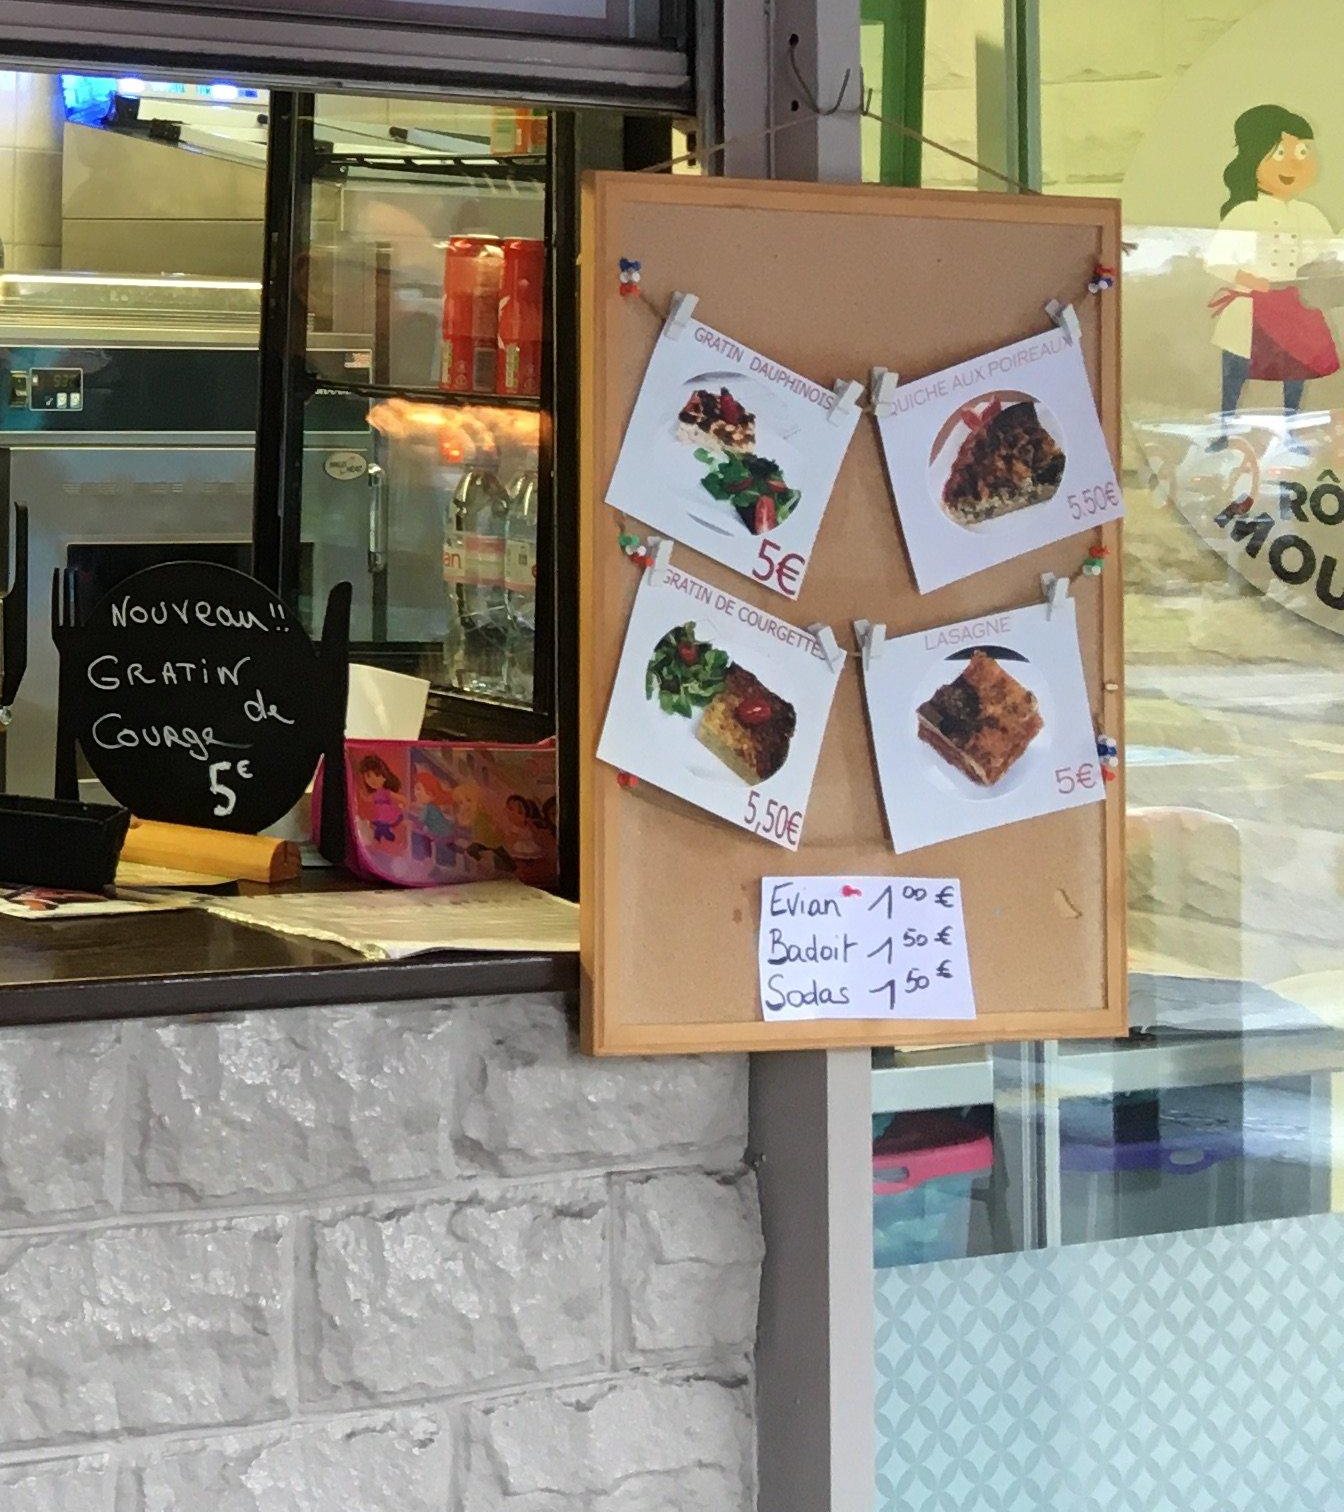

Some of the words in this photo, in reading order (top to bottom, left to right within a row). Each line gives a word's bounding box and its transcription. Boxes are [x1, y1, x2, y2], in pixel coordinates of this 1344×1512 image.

[694, 326, 745, 363] GRATIN
[749, 355, 836, 411] DAUPHINOIS
[952, 365, 986, 390] AUX
[1067, 482, 1119, 521] 5.50€
[752, 538, 806, 596] 5€
[715, 595, 736, 617] DE
[924, 616, 1011, 652] LASAGNE
[243, 689, 295, 725] de
[1055, 763, 1097, 795] 5€
[743, 790, 803, 846] 5,50€
[770, 881, 842, 917] Evian
[767, 928, 859, 965] Badoit
[765, 974, 850, 1011] Sodas
